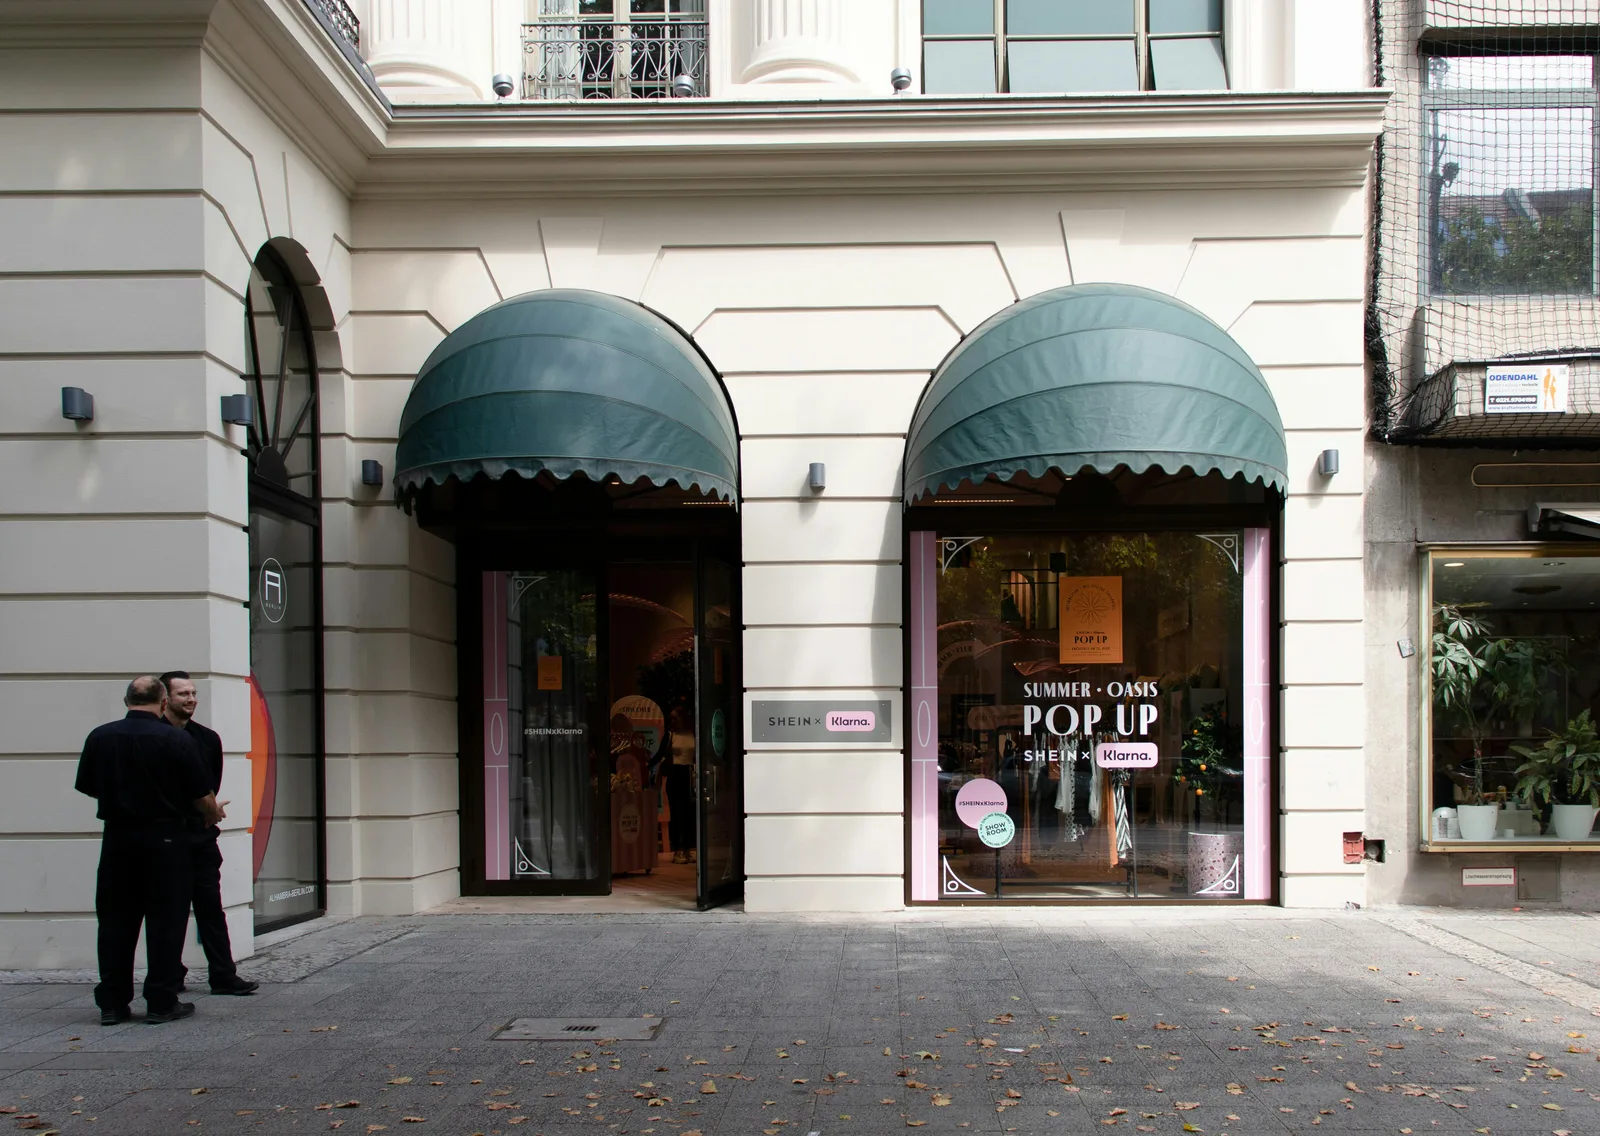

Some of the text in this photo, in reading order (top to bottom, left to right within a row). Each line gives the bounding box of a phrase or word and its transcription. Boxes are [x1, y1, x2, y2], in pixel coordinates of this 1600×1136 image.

[1074, 635, 1108, 644] POP UP
[1024, 682, 1158, 698] SUMMER OASIS
[768, 717, 811, 726] SHEIN
[832, 717, 870, 726] Klarna.
[1024, 704, 1158, 736] POP UP
[1024, 750, 1077, 761] SHEIN
[1104, 750, 1152, 760] Klarna.
[985, 822, 1006, 831] SHOW
[986, 828, 1007, 836] ROOM
